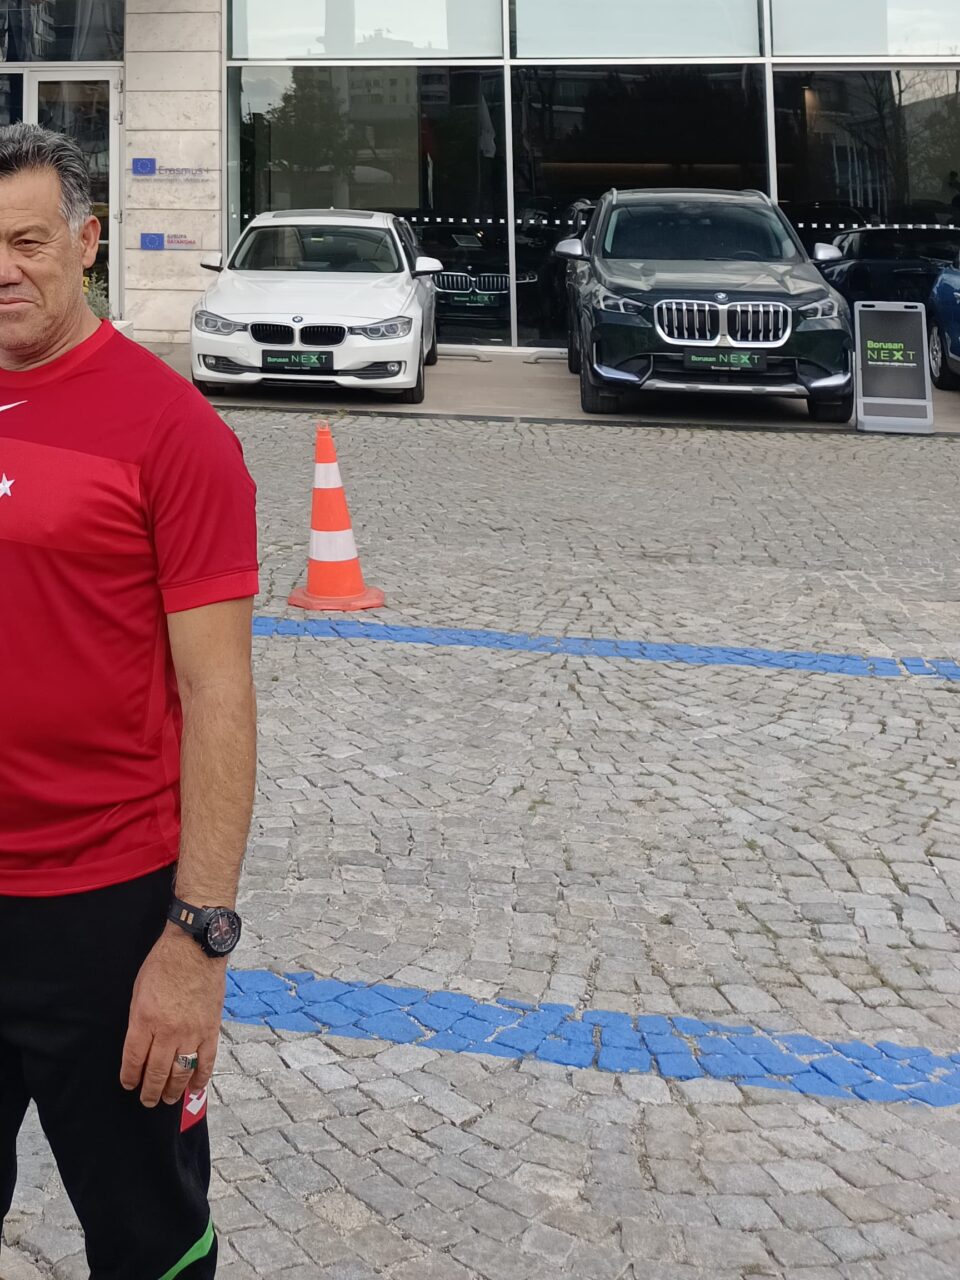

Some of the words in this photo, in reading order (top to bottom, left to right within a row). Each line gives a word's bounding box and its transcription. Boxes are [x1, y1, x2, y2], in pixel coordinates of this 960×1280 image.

[867, 340, 904, 349] Borusan
[291, 354, 328, 363] NEXT
[719, 354, 760, 364] NEXT
[867, 349, 916, 361] NEXT
